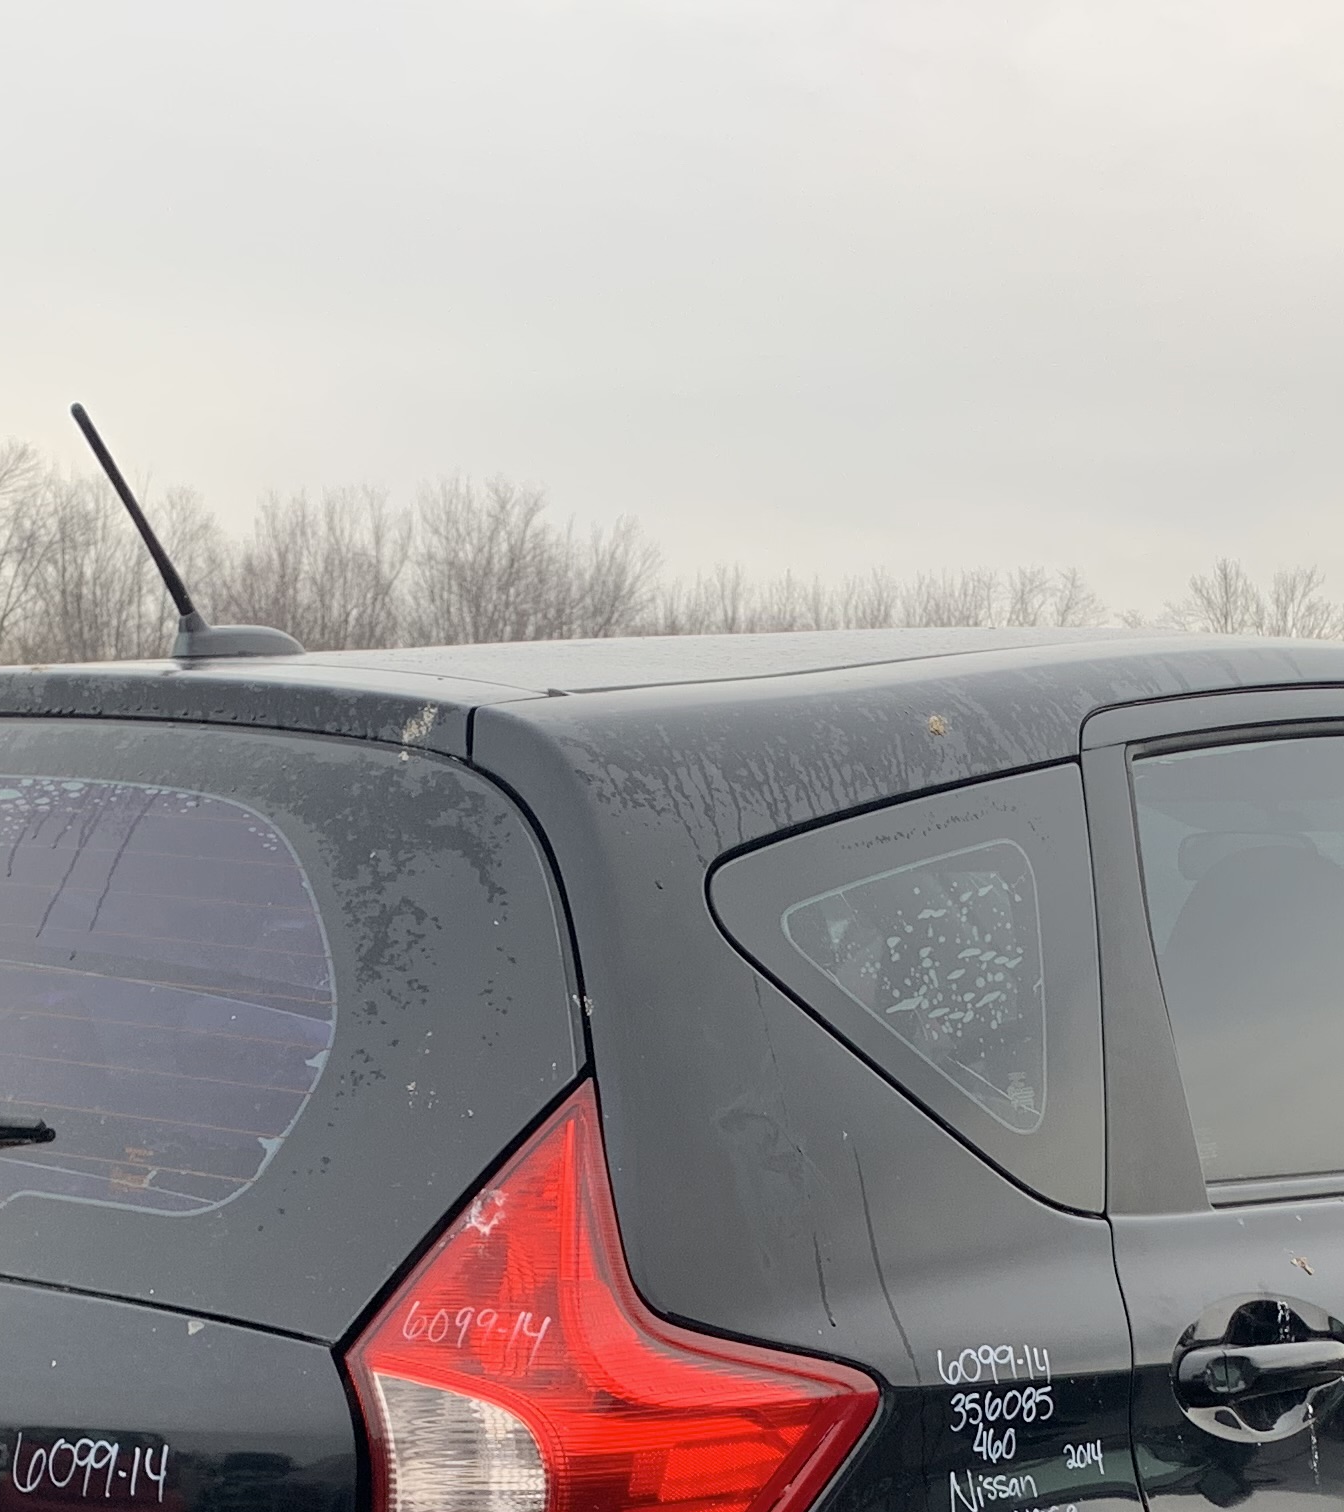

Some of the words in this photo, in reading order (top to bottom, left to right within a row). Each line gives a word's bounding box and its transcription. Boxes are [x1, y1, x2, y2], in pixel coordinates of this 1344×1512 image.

[402, 1301, 552, 1368] 6099-14
[937, 1344, 1052, 1385] 6099-14
[950, 1386, 1055, 1432] 356085
[973, 1422, 1017, 1464] 460
[1063, 1439, 1105, 1475] 2014
[13, 1432, 169, 1503] 6099-14
